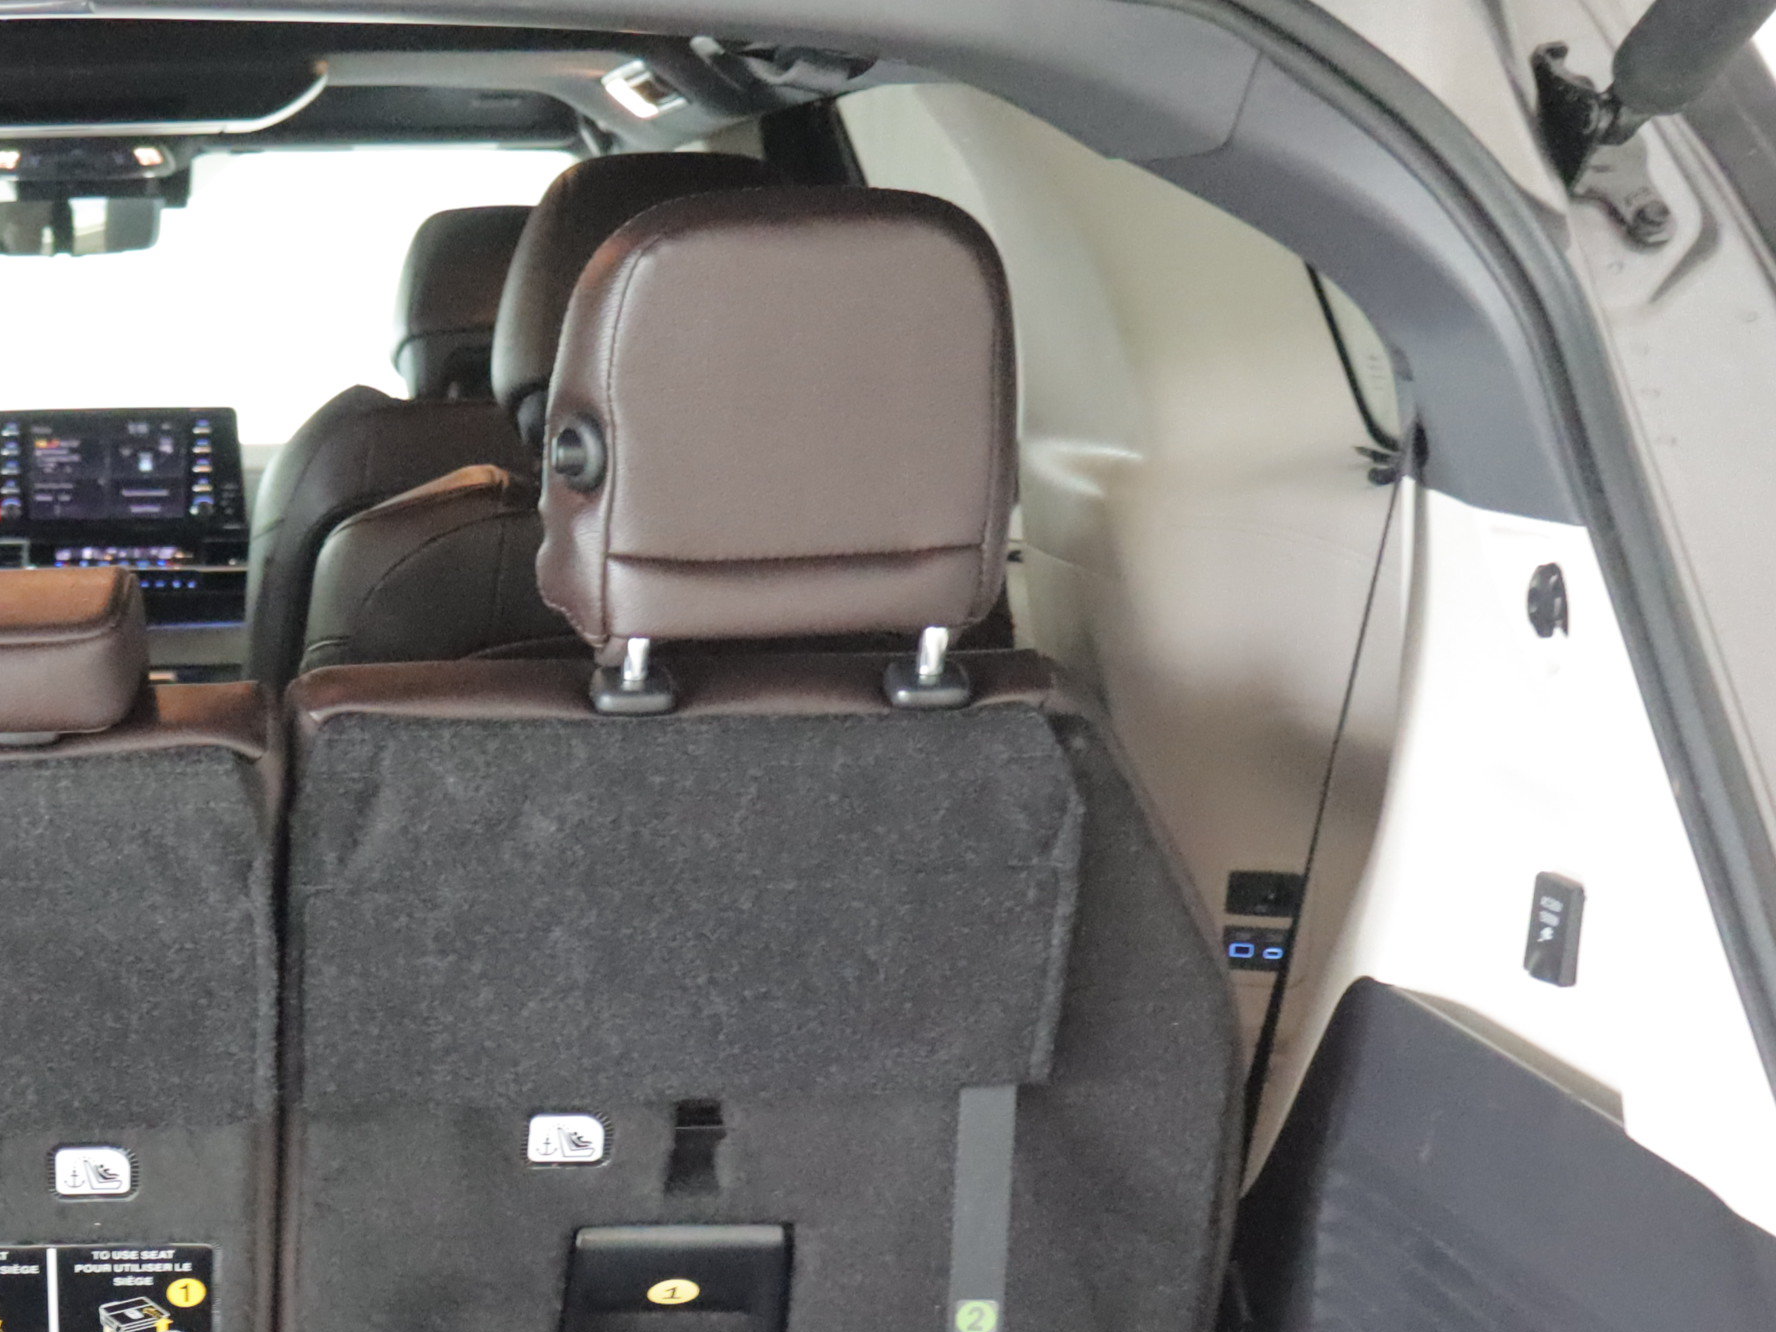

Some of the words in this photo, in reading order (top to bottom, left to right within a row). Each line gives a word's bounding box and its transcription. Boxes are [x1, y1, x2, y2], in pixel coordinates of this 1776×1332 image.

[92, 1251, 111, 1260] TO
[112, 1251, 139, 1260] USE
[140, 1250, 175, 1259] SEAT
[74, 1264, 112, 1273] POUR
[113, 1263, 173, 1273] UTILISER
[174, 1262, 192, 1272] LE
[179, 1283, 190, 1303] 1
[966, 1306, 986, 1332] 2
